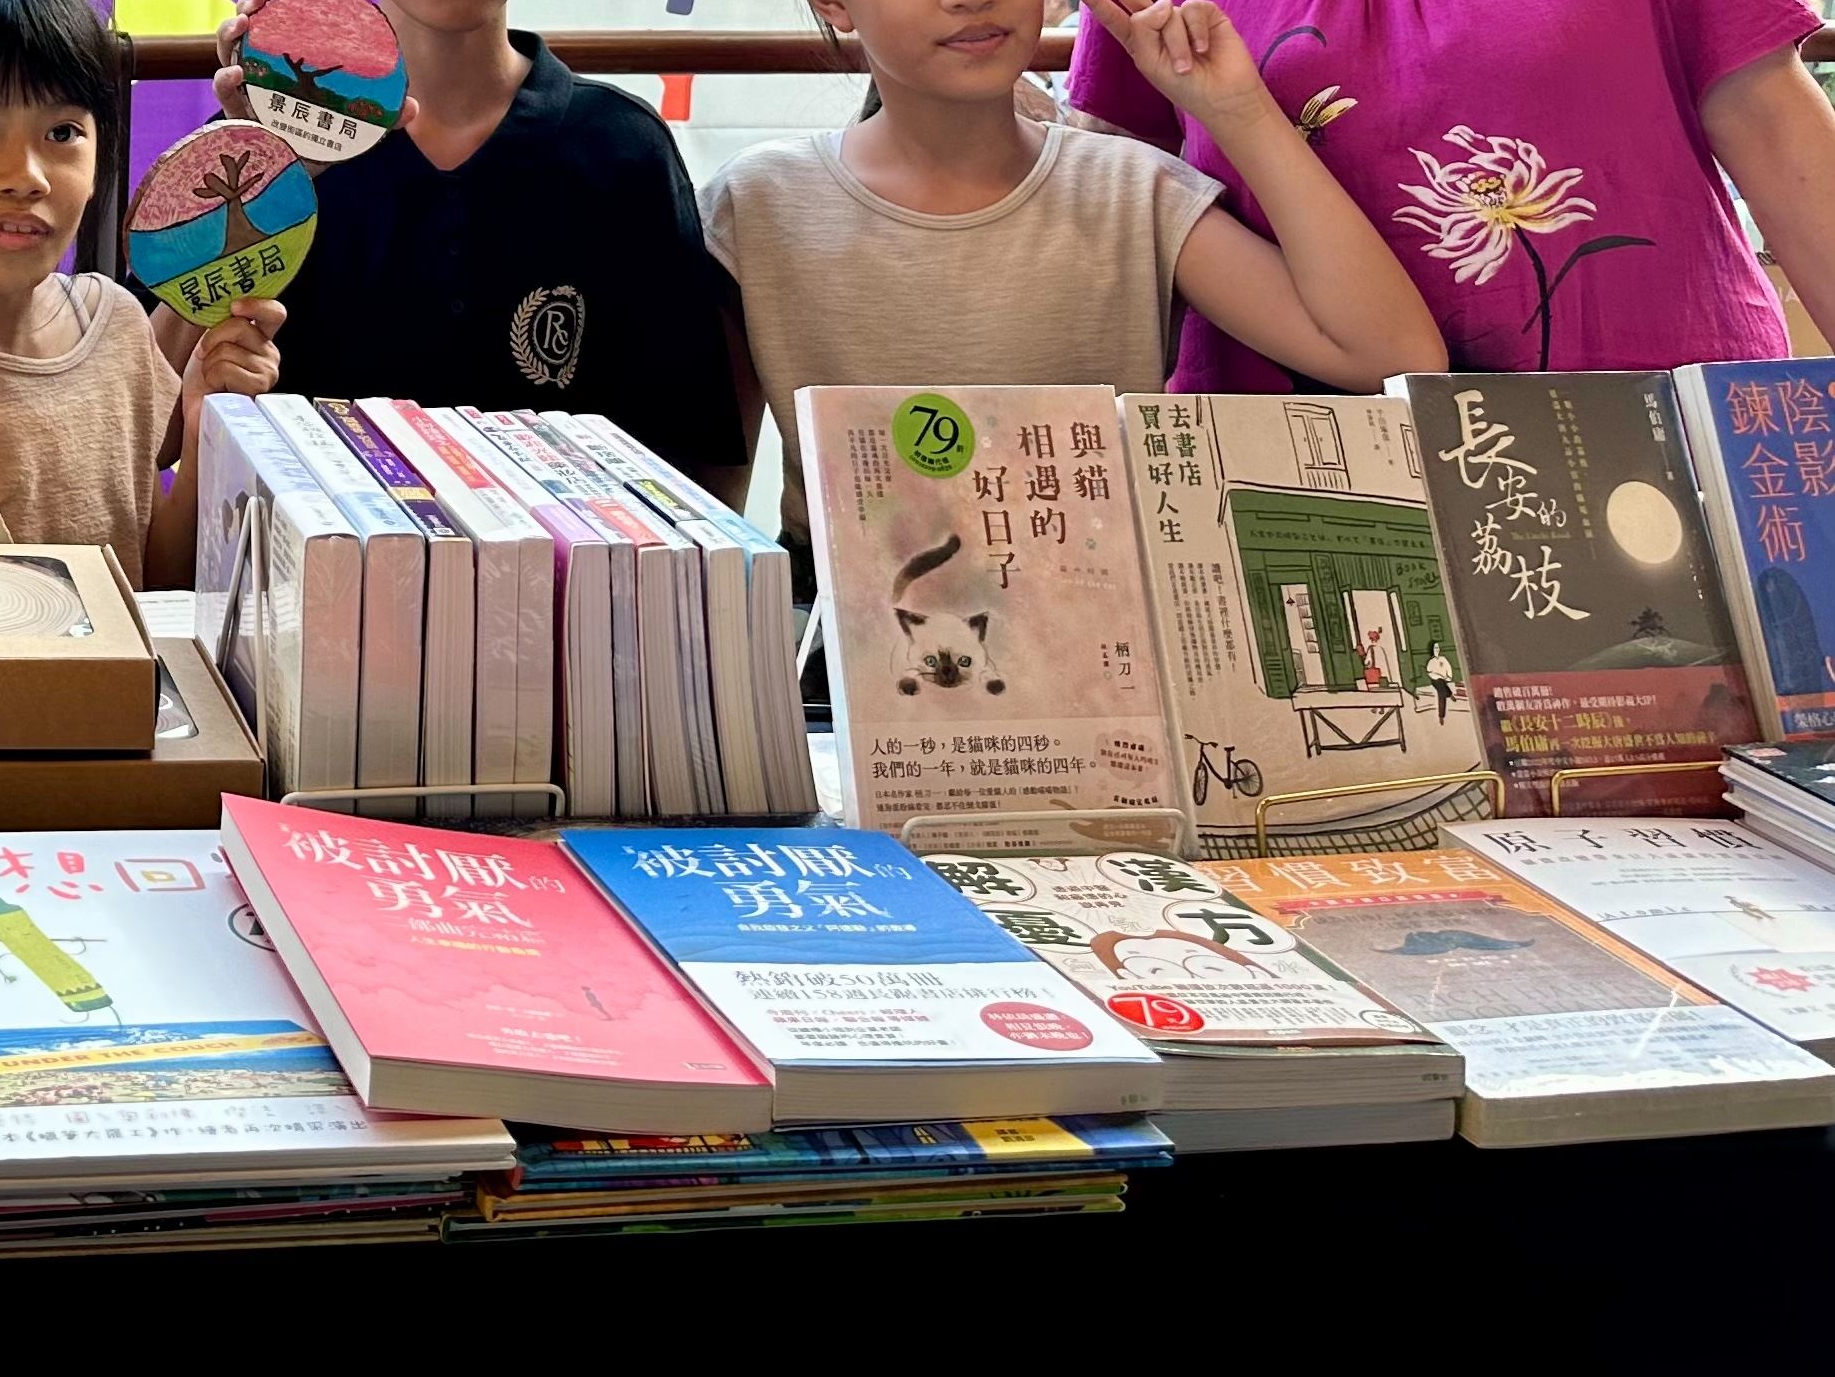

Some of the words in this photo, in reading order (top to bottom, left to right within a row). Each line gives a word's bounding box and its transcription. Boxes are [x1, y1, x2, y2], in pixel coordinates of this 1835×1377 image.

[268, 93, 357, 139] 景辰書局
[180, 244, 286, 314] 景辰書局
[1069, 422, 1110, 500] 與貓
[1138, 404, 1184, 543] 買個好人生
[1168, 404, 1202, 487] 去書店
[1726, 382, 1807, 563] 鍊金術
[1016, 423, 1066, 545] 相遇的
[972, 465, 1021, 589] 好日子
[870, 735, 1061, 756] 人的一秒，是貓咪的四秒。
[872, 758, 1097, 779] 我們的一年，就是貓咪的四年。
[281, 824, 566, 894] 被討厭的
[622, 842, 912, 882] 被討厭的
[1482, 826, 1764, 854] 原子習慣
[365, 878, 531, 928] 勇氣
[722, 879, 892, 919] 勇氣
[1, 1049, 91, 1069] UNDER
[98, 1045, 148, 1060] THE
[153, 1039, 239, 1055] COUCH
